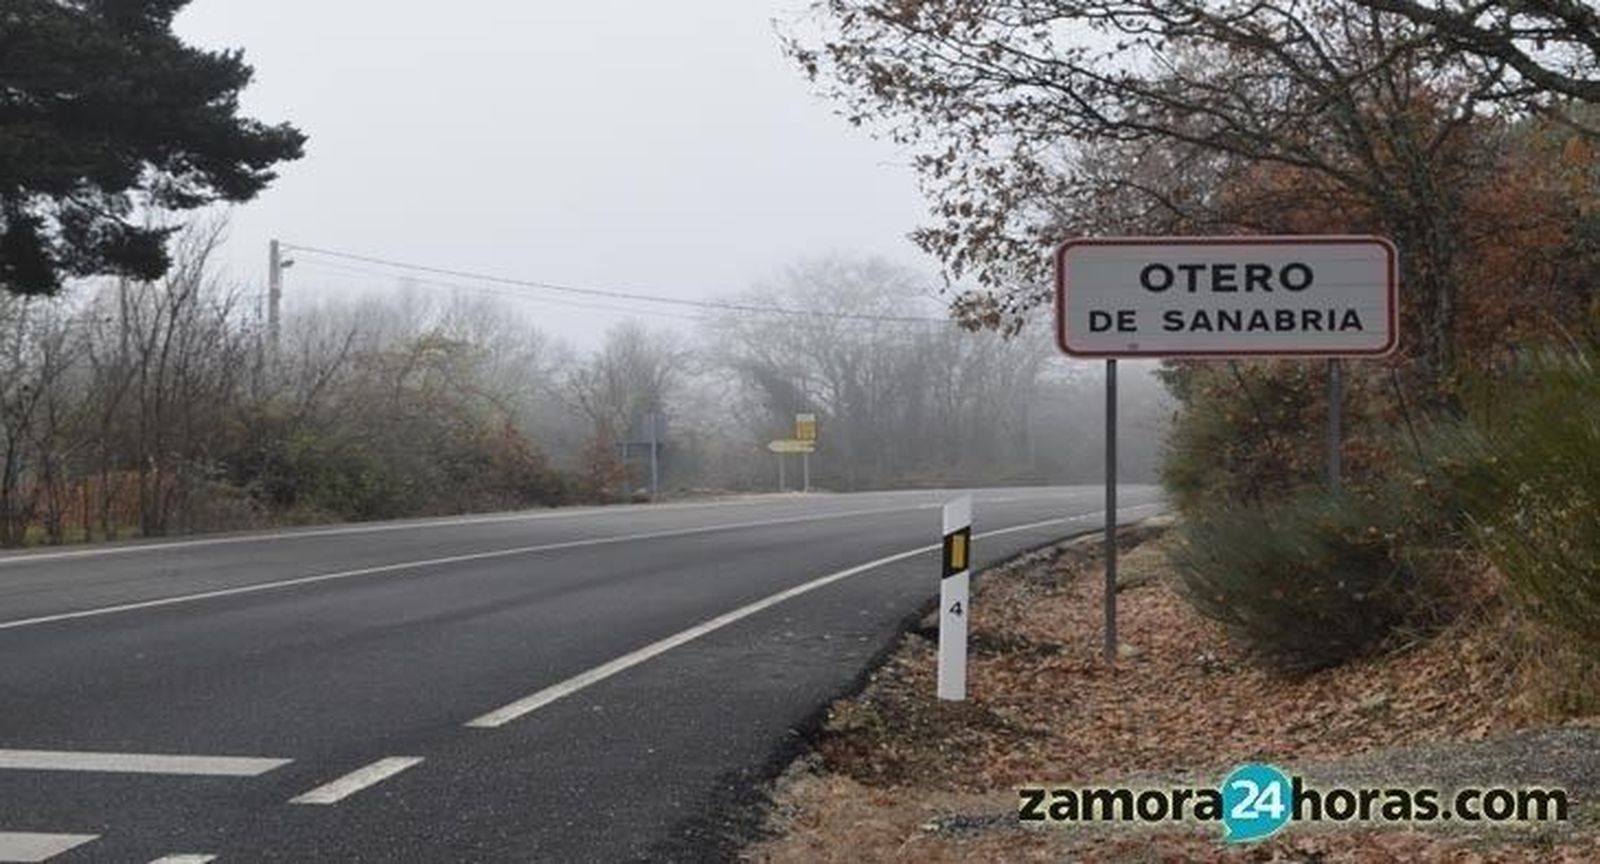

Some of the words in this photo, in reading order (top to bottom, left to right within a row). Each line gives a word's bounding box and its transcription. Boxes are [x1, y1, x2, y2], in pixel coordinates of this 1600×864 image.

[1139, 262, 1314, 293] OTERO
[1088, 309, 1138, 333] DE
[1162, 308, 1363, 333] SANABRIA
[949, 601, 963, 616] 4
